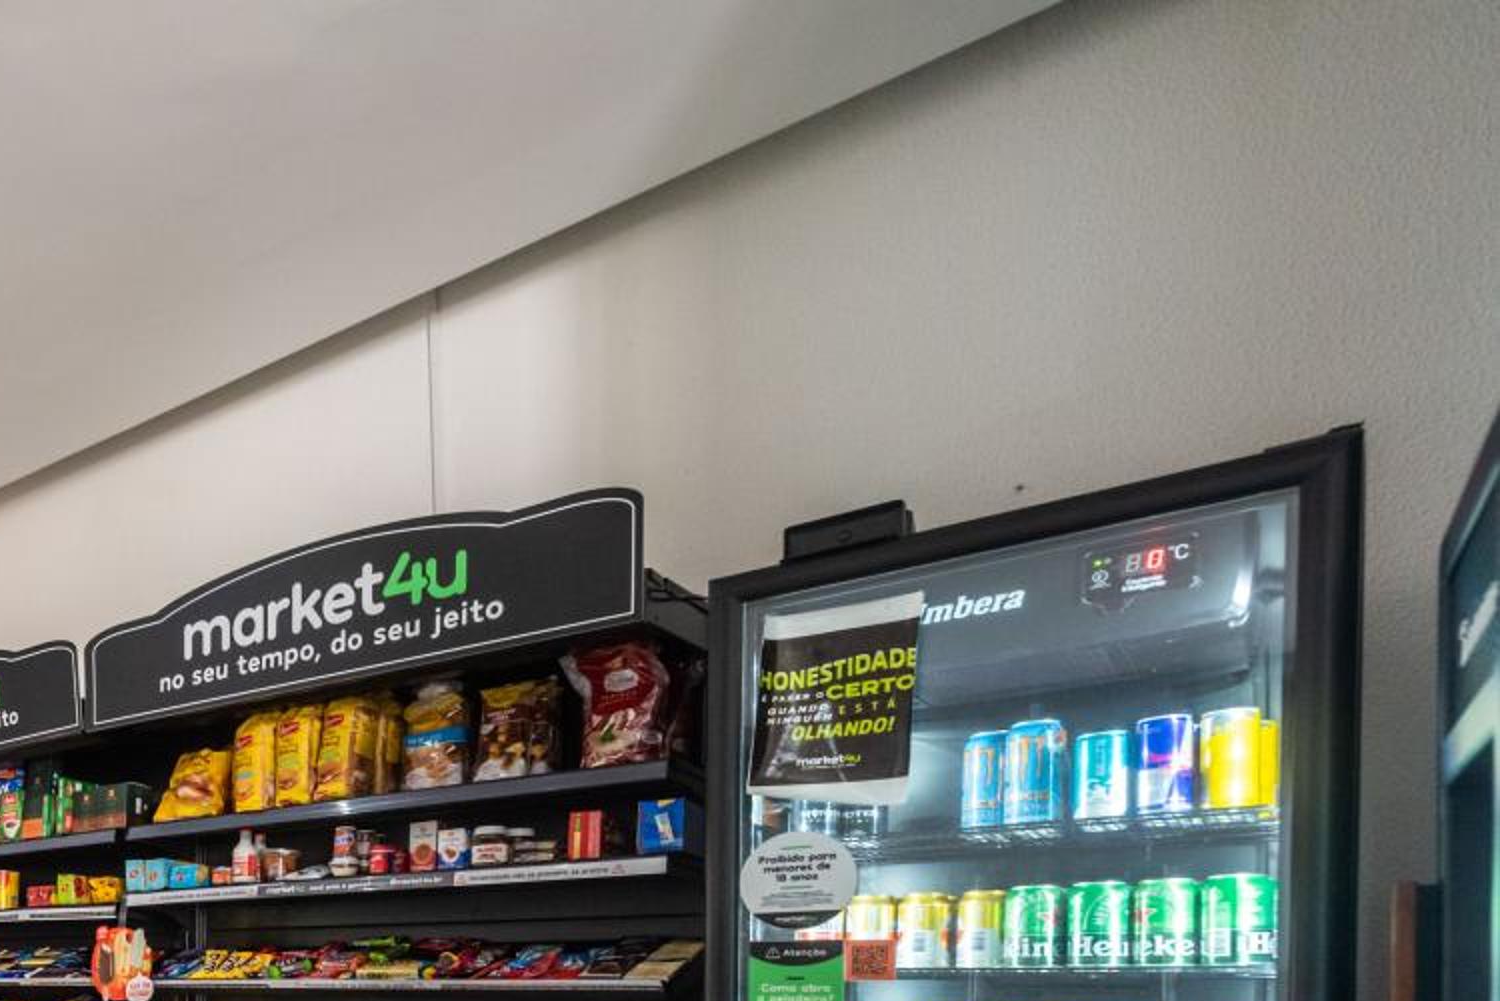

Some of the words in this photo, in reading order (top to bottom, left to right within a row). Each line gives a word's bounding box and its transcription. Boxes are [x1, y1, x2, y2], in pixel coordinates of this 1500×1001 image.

[183, 549, 468, 661] market4u
[158, 675, 185, 692] no
[191, 662, 230, 686] seu
[237, 643, 322, 672] tempo,
[329, 629, 363, 655] do
[372, 618, 422, 645] seu
[430, 599, 504, 639] jeito
[760, 647, 917, 692] HONESTIDADE
[825, 674, 915, 700] CERTO
[767, 703, 832, 716] QUANDO
[791, 716, 896, 742] OLHANDO!
[758, 853, 805, 865] Proibido
[808, 852, 837, 864] para
[763, 864, 814, 875] menores
[816, 862, 831, 872] de
[775, 874, 787, 883] 18
[790, 872, 819, 882] anos
[782, 947, 827, 958] Atenção
